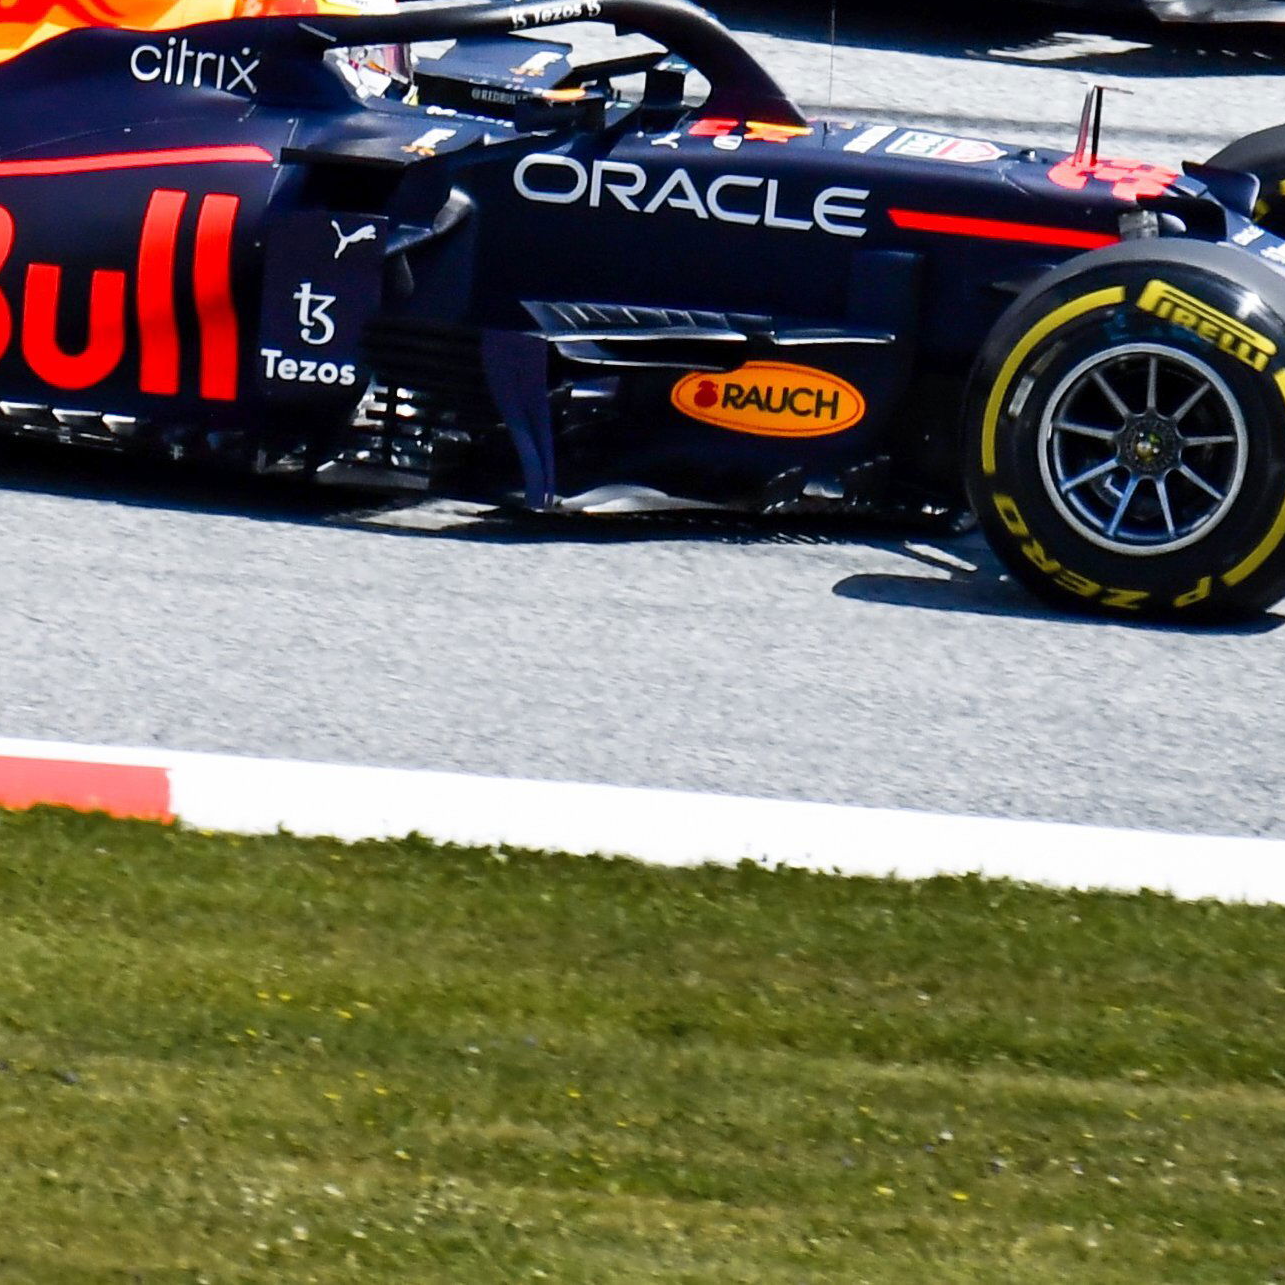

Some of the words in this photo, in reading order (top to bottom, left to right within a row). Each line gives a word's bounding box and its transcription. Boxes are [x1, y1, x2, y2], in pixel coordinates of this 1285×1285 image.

[533, 2, 584, 26] Tezos
[130, 33, 260, 95] citrix
[513, 152, 871, 239] ORACLE
[1135, 278, 1278, 373] PIRELLI
[260, 347, 357, 387] Tezos
[720, 382, 840, 421] RAUCH
[992, 492, 1152, 610] ZERO
